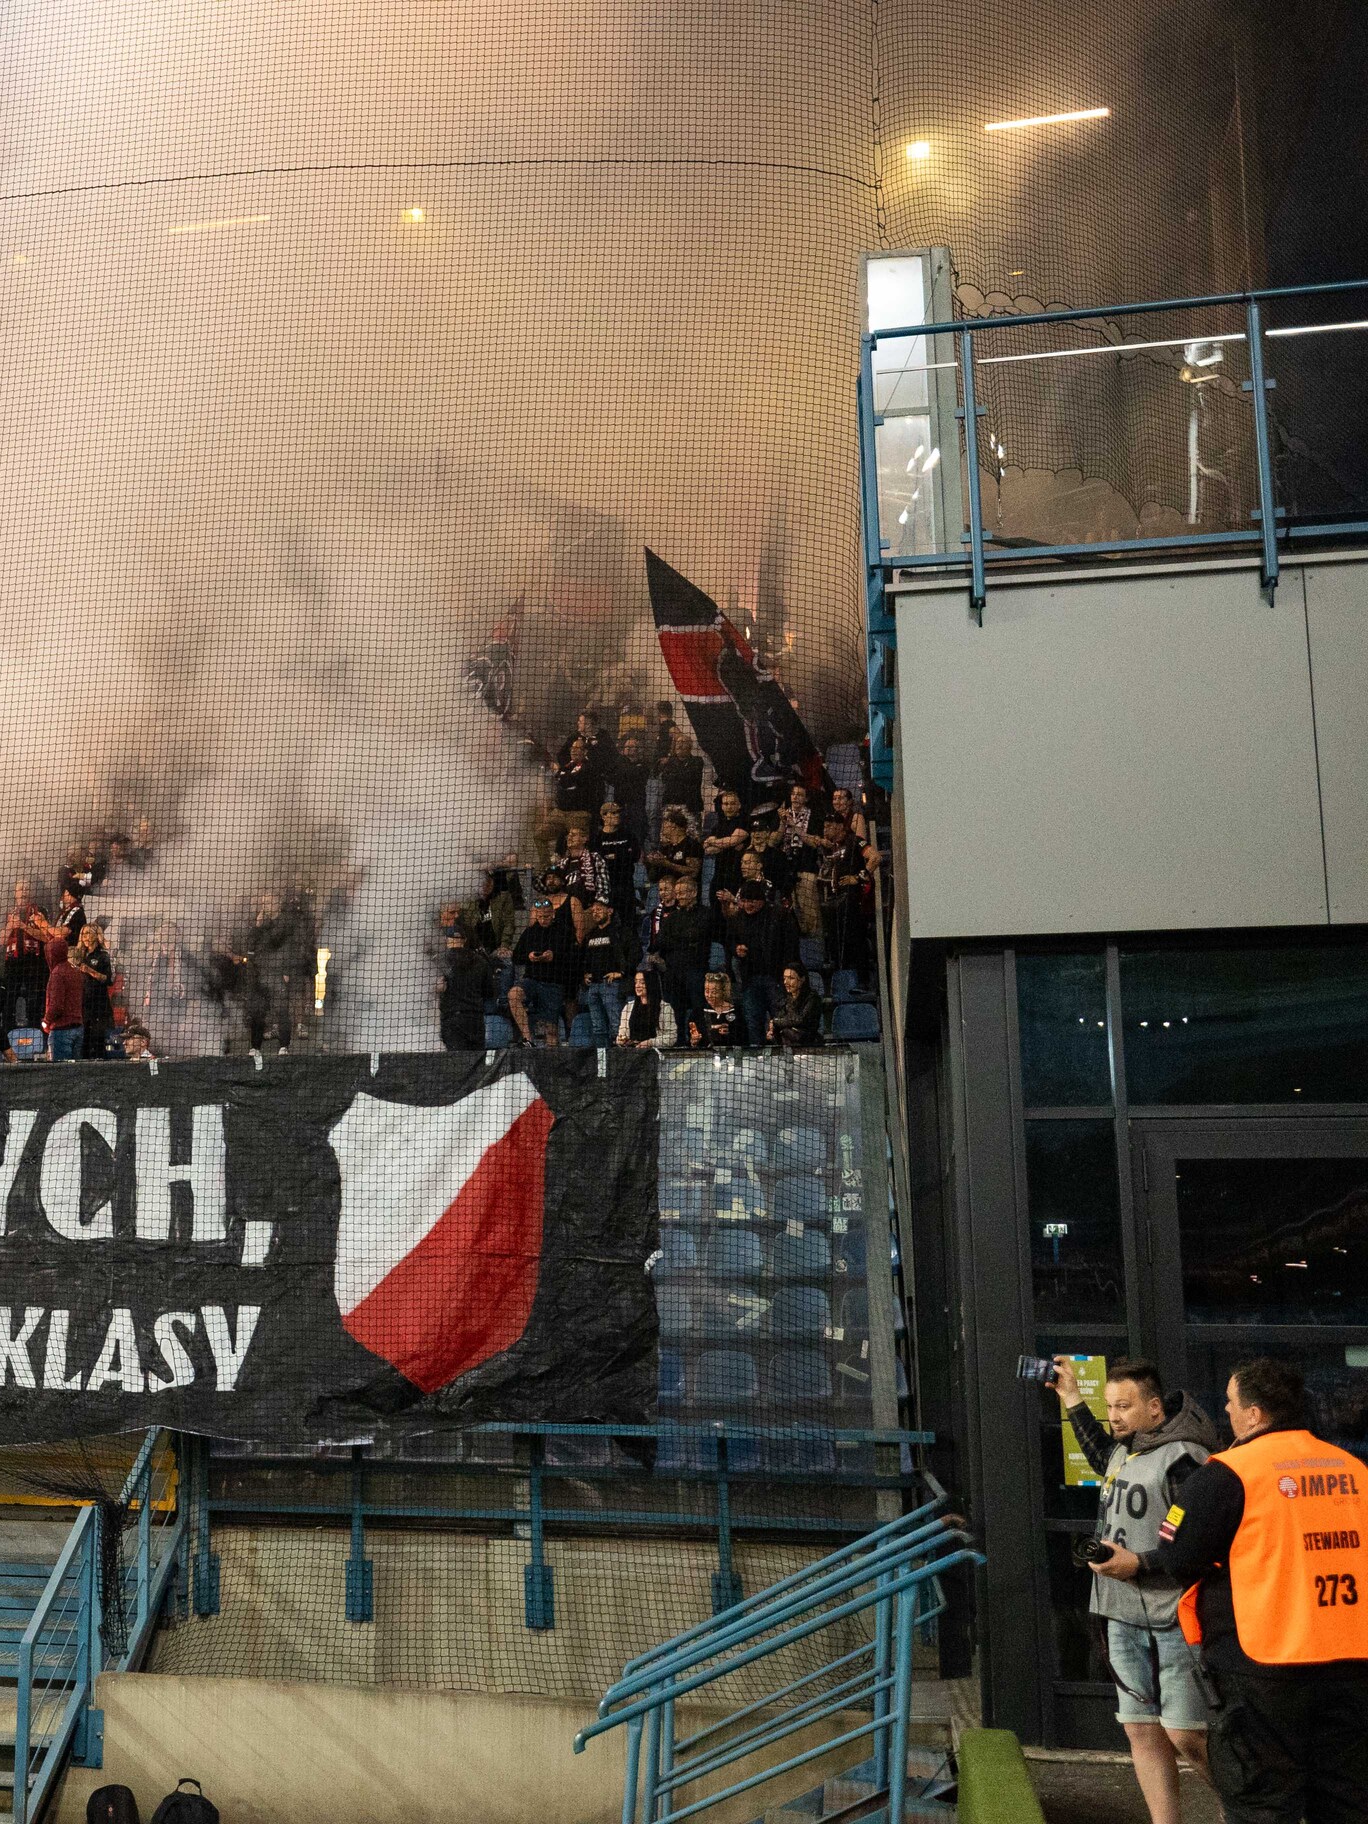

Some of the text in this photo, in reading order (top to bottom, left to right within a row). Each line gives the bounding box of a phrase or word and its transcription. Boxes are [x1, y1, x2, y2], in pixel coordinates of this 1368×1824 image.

[1300, 1474, 1359, 1497] IMPEL
[1303, 1530, 1360, 1551] STEWARD
[1315, 1573, 1358, 1607] 273
